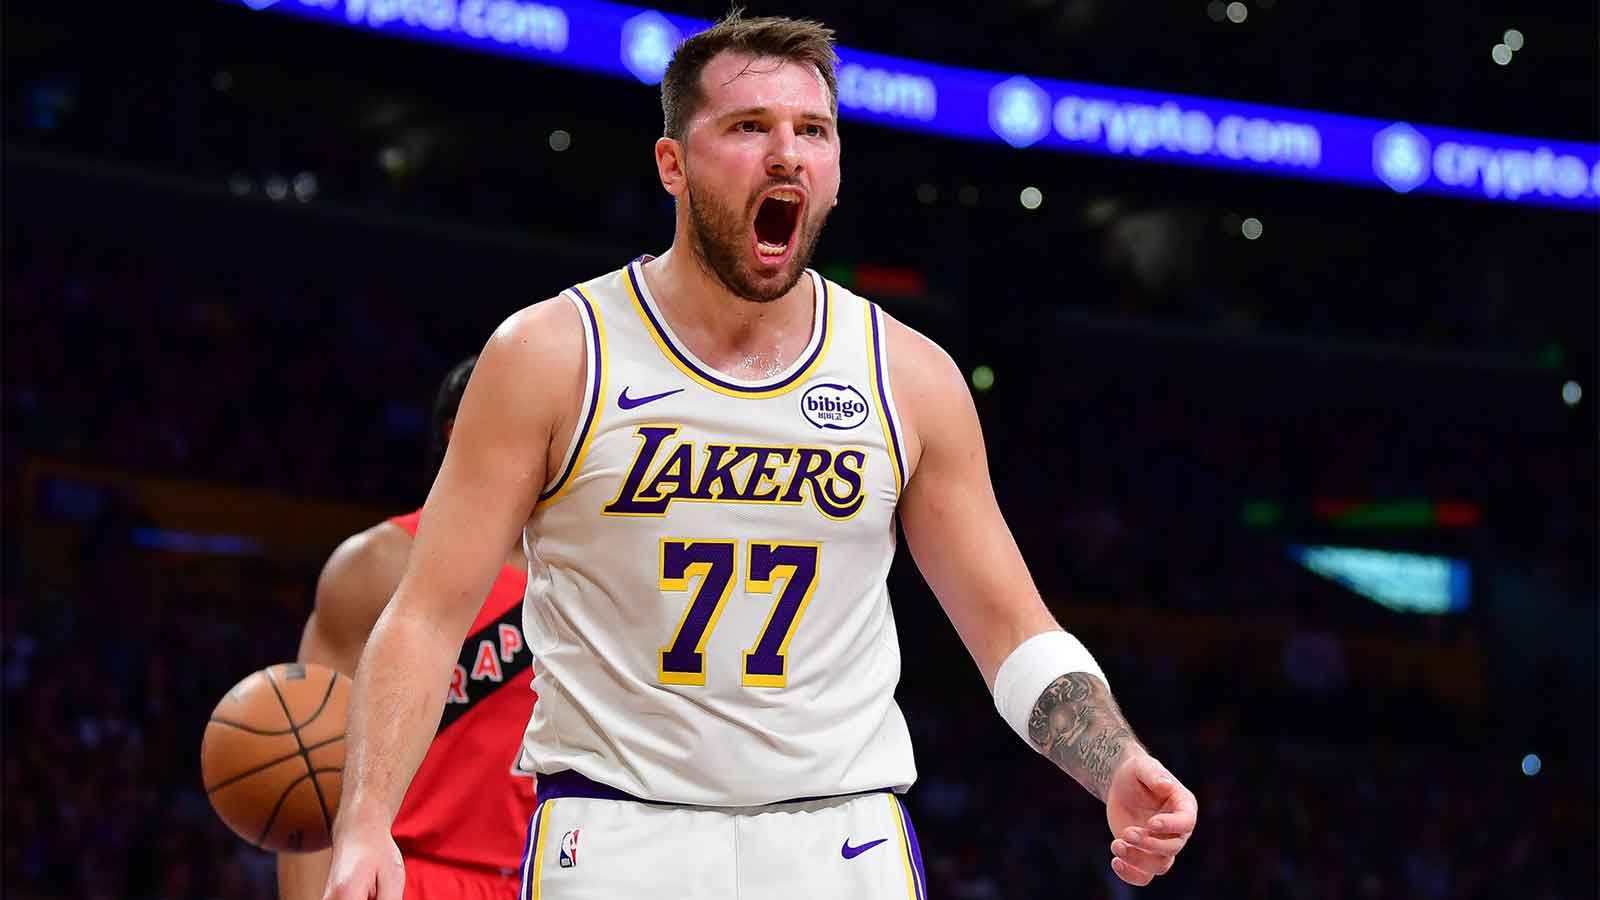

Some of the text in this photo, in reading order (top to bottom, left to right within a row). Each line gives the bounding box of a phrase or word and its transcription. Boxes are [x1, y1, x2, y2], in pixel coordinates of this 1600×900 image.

[1053, 96, 1322, 169] crypto.com
[807, 395, 864, 417] bibigo
[601, 423, 867, 521] LAKERS
[659, 537, 821, 688] 77
[447, 623, 522, 704] RAP
